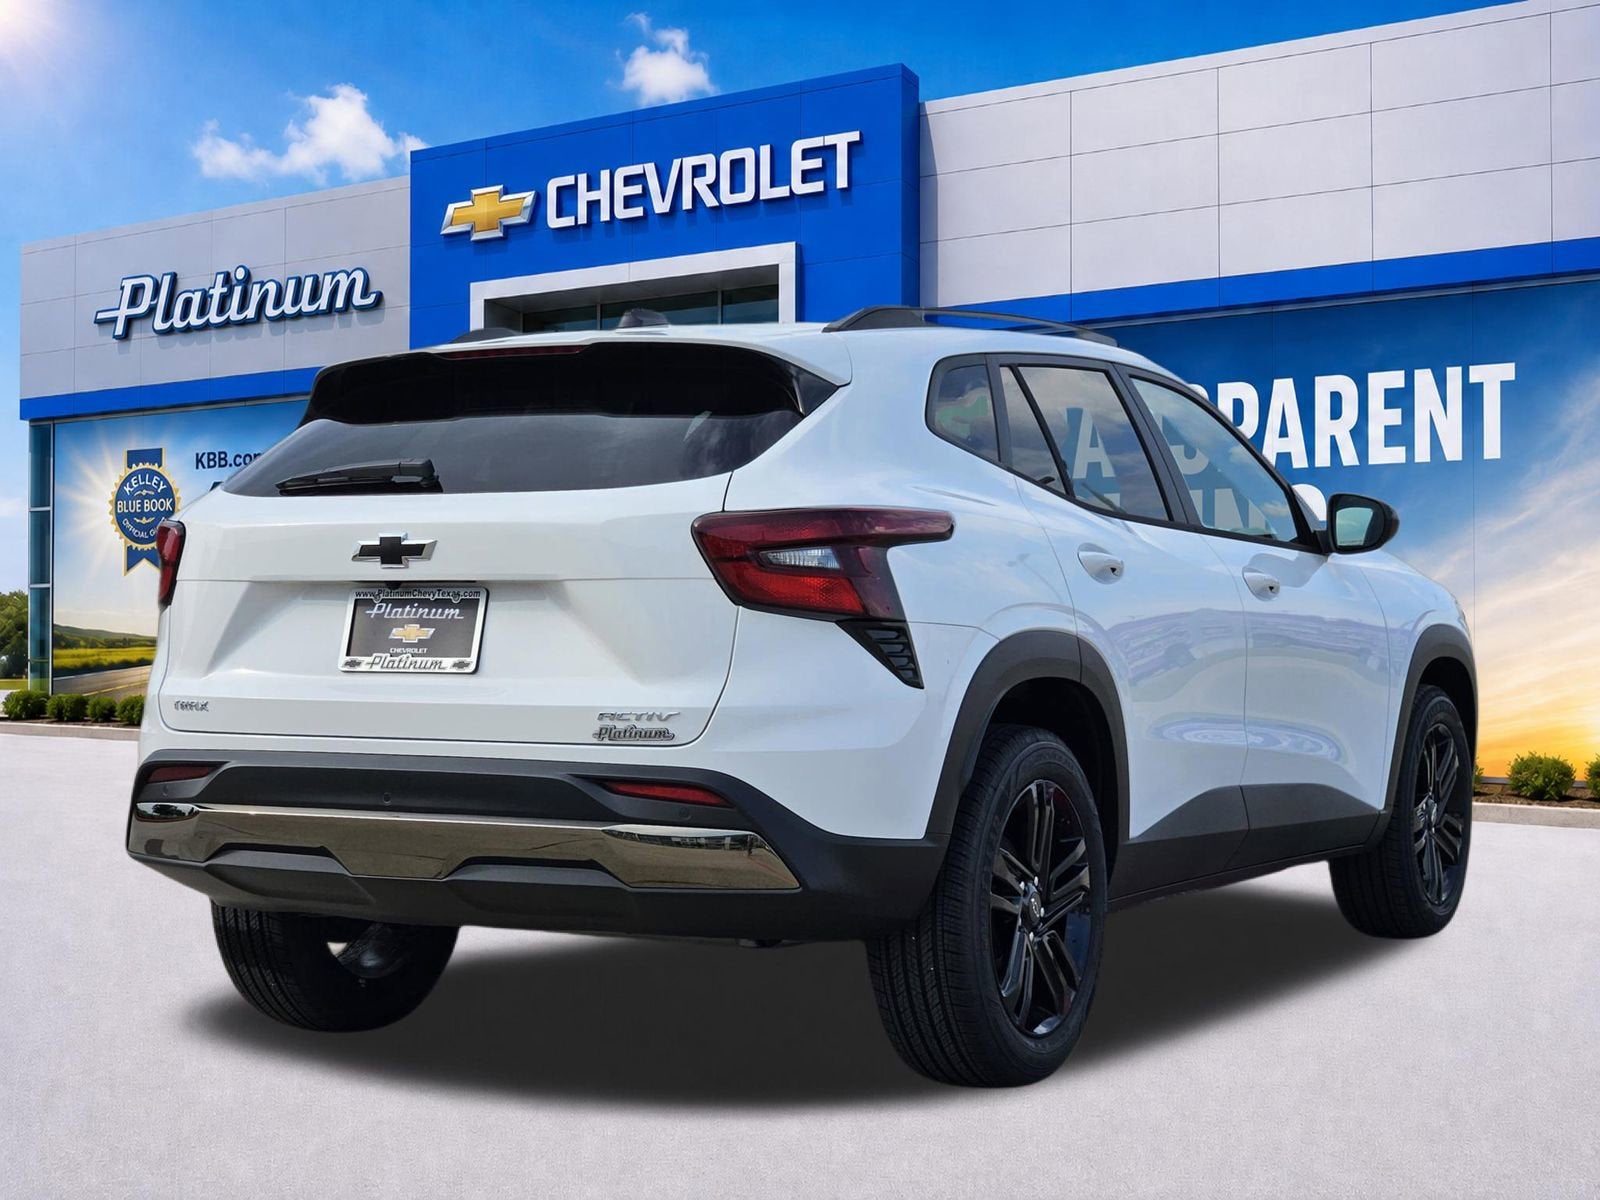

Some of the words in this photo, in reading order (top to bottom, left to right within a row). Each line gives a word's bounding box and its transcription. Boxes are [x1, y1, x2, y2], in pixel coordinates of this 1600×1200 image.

[546, 130, 861, 230] CHEVROLET
[94, 265, 382, 340] Platinum
[123, 474, 167, 496] KELLEY
[117, 500, 142, 513] BLUE
[143, 498, 173, 513] BOOK
[355, 588, 481, 600] www.PlatinumChevyTexas.com
[365, 603, 465, 619] Platinum
[367, 655, 448, 670] Platinum
[592, 724, 675, 741] Platinum
